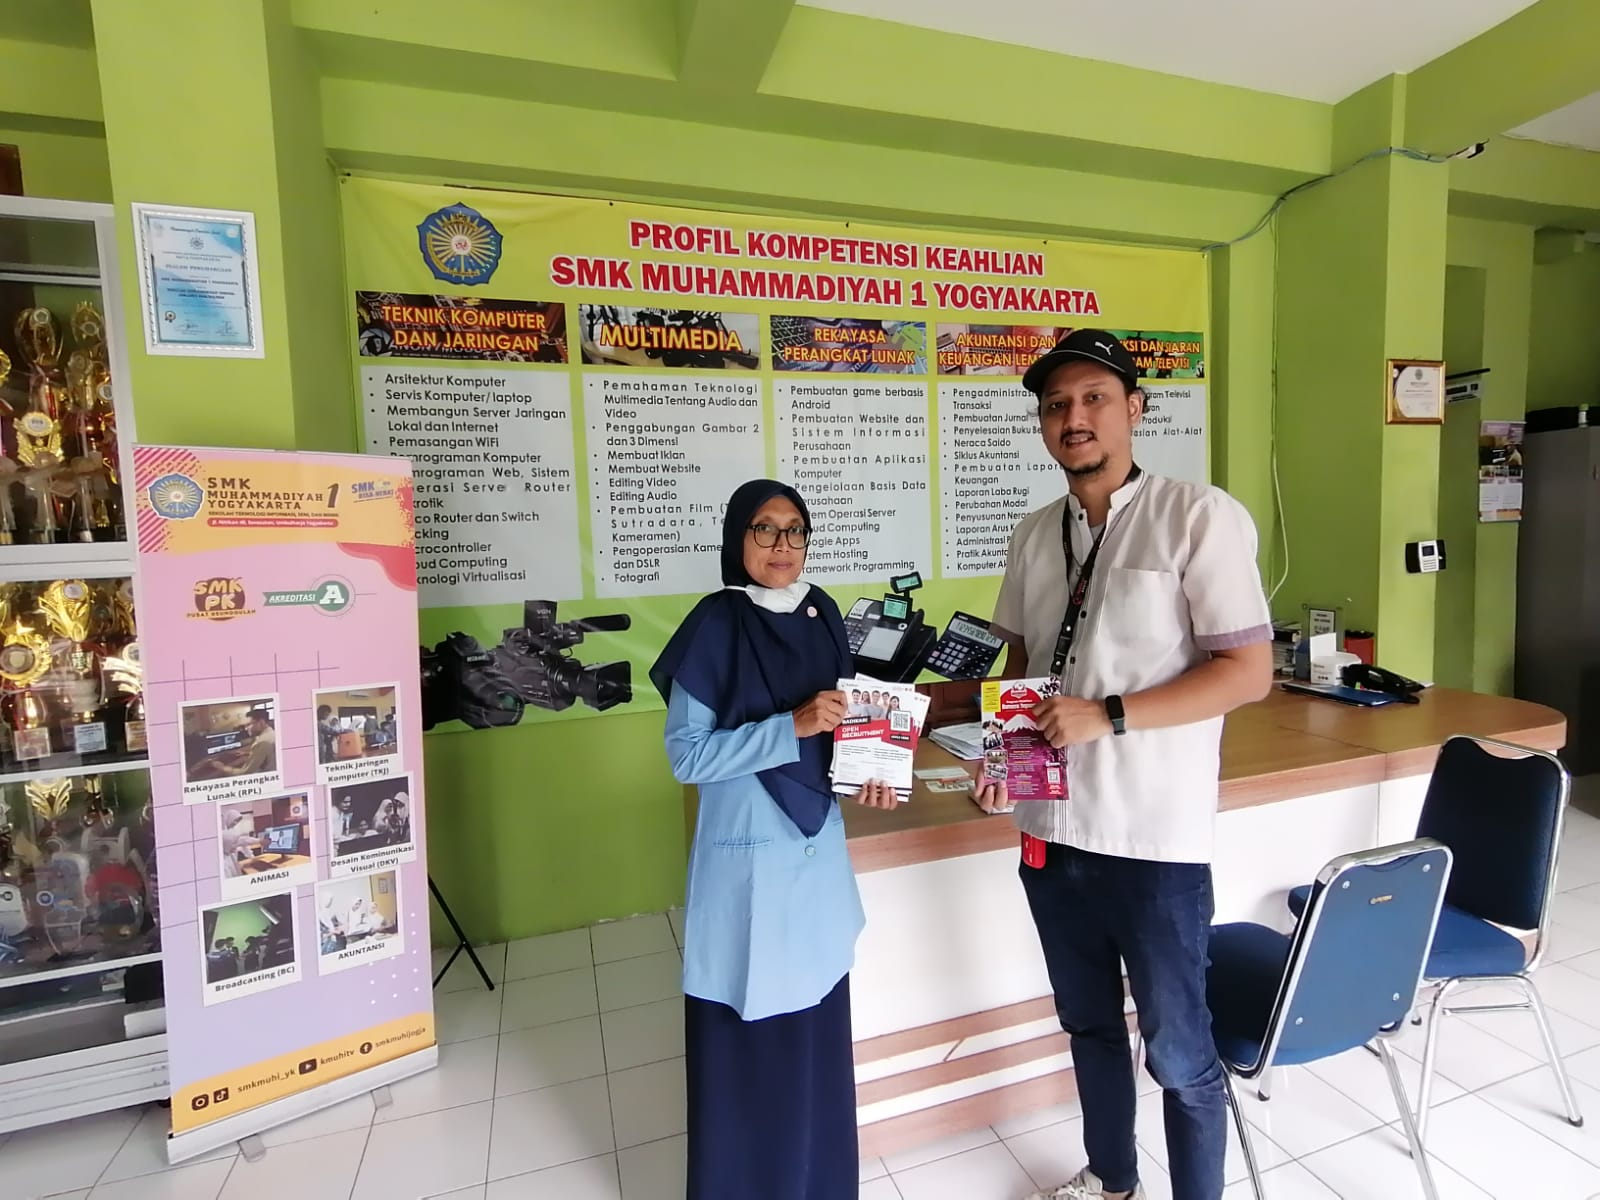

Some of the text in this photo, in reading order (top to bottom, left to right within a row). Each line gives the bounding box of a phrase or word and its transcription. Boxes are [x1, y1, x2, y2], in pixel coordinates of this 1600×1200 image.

[630, 221, 1045, 276] PROFIL KOMPETENSI KEAHLIAN
[550, 256, 1100, 315] SMK MUHAMMADIYAH 1 YOGYAKARTA
[382, 305, 546, 330] TEKNIK KOMPUTER
[394, 331, 436, 346] DAN
[444, 333, 538, 351] JARINGAN
[600, 324, 743, 353] MULTIMEDIA
[814, 327, 886, 344] REKAYASA
[955, 333, 1057, 349] AKUNTANSI DAN
[1141, 341, 1200, 353] DAN SIARAN
[783, 345, 915, 365] PERANGKAT LUNAK
[938, 351, 1017, 366] KEUANGAN
[1155, 357, 1189, 369] TELEVISI
[385, 374, 506, 387] Arsitektur Komputer
[603, 380, 757, 395] Pemahaman Teknologi
[790, 385, 923, 398] Pembuatan game berbasis
[385, 389, 422, 400] Servis
[1165, 390, 1191, 398] Televisi
[605, 395, 758, 407] Multimedia Tentang Audio dan
[791, 399, 831, 409] Android
[953, 401, 991, 410] Transaksi
[387, 406, 566, 420] Membangun Server Jaringan
[605, 408, 636, 418] Video
[792, 414, 924, 424] Pembuatan Website dan
[954, 413, 1028, 423] Pembuatan Jurnal
[388, 422, 498, 433] Lokal dan Internet
[606, 422, 759, 434] Penggabungan Gambar 2
[793, 427, 925, 437] Sistem Informasi
[954, 426, 1031, 437] Penyelesaian Buku
[1163, 427, 1202, 435] Alat-Alat
[390, 437, 499, 449] Pemasangan WiFi
[607, 436, 678, 446] dan 3 Dimensi
[793, 441, 851, 451] Perusahaan
[954, 438, 1011, 448] Neraca Saldo
[483, 453, 541, 464] Komputer
[608, 450, 685, 460] Membuat Iklan
[794, 454, 926, 465] Pembuatan Aplikasi
[954, 450, 1020, 460] Siklus Akuntansi
[492, 468, 570, 479] Web, Sistem
[608, 463, 701, 474] Membuat Website
[794, 468, 842, 479] Komputer
[955, 463, 1020, 473] Pembuatan
[352, 481, 374, 493] SMK
[525, 482, 570, 492] Router
[609, 477, 676, 489] Editing Video
[795, 481, 926, 493] Pengelolaan Basis Data
[955, 476, 999, 486] Keuangan
[208, 477, 339, 508] SMK 1
[208, 491, 323, 501] MUHAMMADIYAH
[610, 490, 677, 503] Editing Audio
[955, 487, 1030, 498] Laporan Laba Rugi
[208, 500, 301, 510] YOGYAKARTA
[611, 504, 713, 515] Pembuatan Film
[956, 500, 1027, 510] Perubahan Modal
[434, 511, 539, 523] Router dan Switch
[829, 508, 896, 520] Operasi Server
[956, 513, 1006, 523] Penyusunan
[611, 517, 703, 529] Sutradara,
[827, 522, 880, 534] Computing
[956, 524, 1009, 536] Laporan Arus
[612, 531, 681, 542] Kameramen)
[835, 535, 860, 546] Apps
[957, 536, 1005, 546] Administrasi
[613, 544, 690, 557] Pengoperasian
[833, 548, 868, 560] Hosting
[957, 549, 980, 558] Pratik
[439, 556, 507, 569] Computing
[614, 558, 660, 570] dan DSLR
[853, 560, 914, 573] Programming
[958, 561, 996, 571] Komputer
[463, 570, 526, 582] Virtualisasi
[615, 571, 660, 584] Fotografi
[193, 577, 242, 595] SMK
[269, 585, 344, 604] AKREDITASI A
[205, 594, 236, 611] PK
[325, 758, 389, 773] Teknik Jaringan
[328, 768, 389, 782] Komputer (TKJ)
[183, 774, 280, 794] Rekayasa Perangkat
[207, 787, 262, 801] Lunak (RPL)
[330, 856, 359, 867] Desain
[350, 858, 399, 873] Visual (DKV)
[250, 871, 290, 885] ANIMASI
[338, 943, 385, 960] AKUNTANSI
[215, 966, 295, 992] Broadcasting (BC)
[237, 1026, 426, 1093] smkmuhi_yk kmuhitv smkmuhijogja
